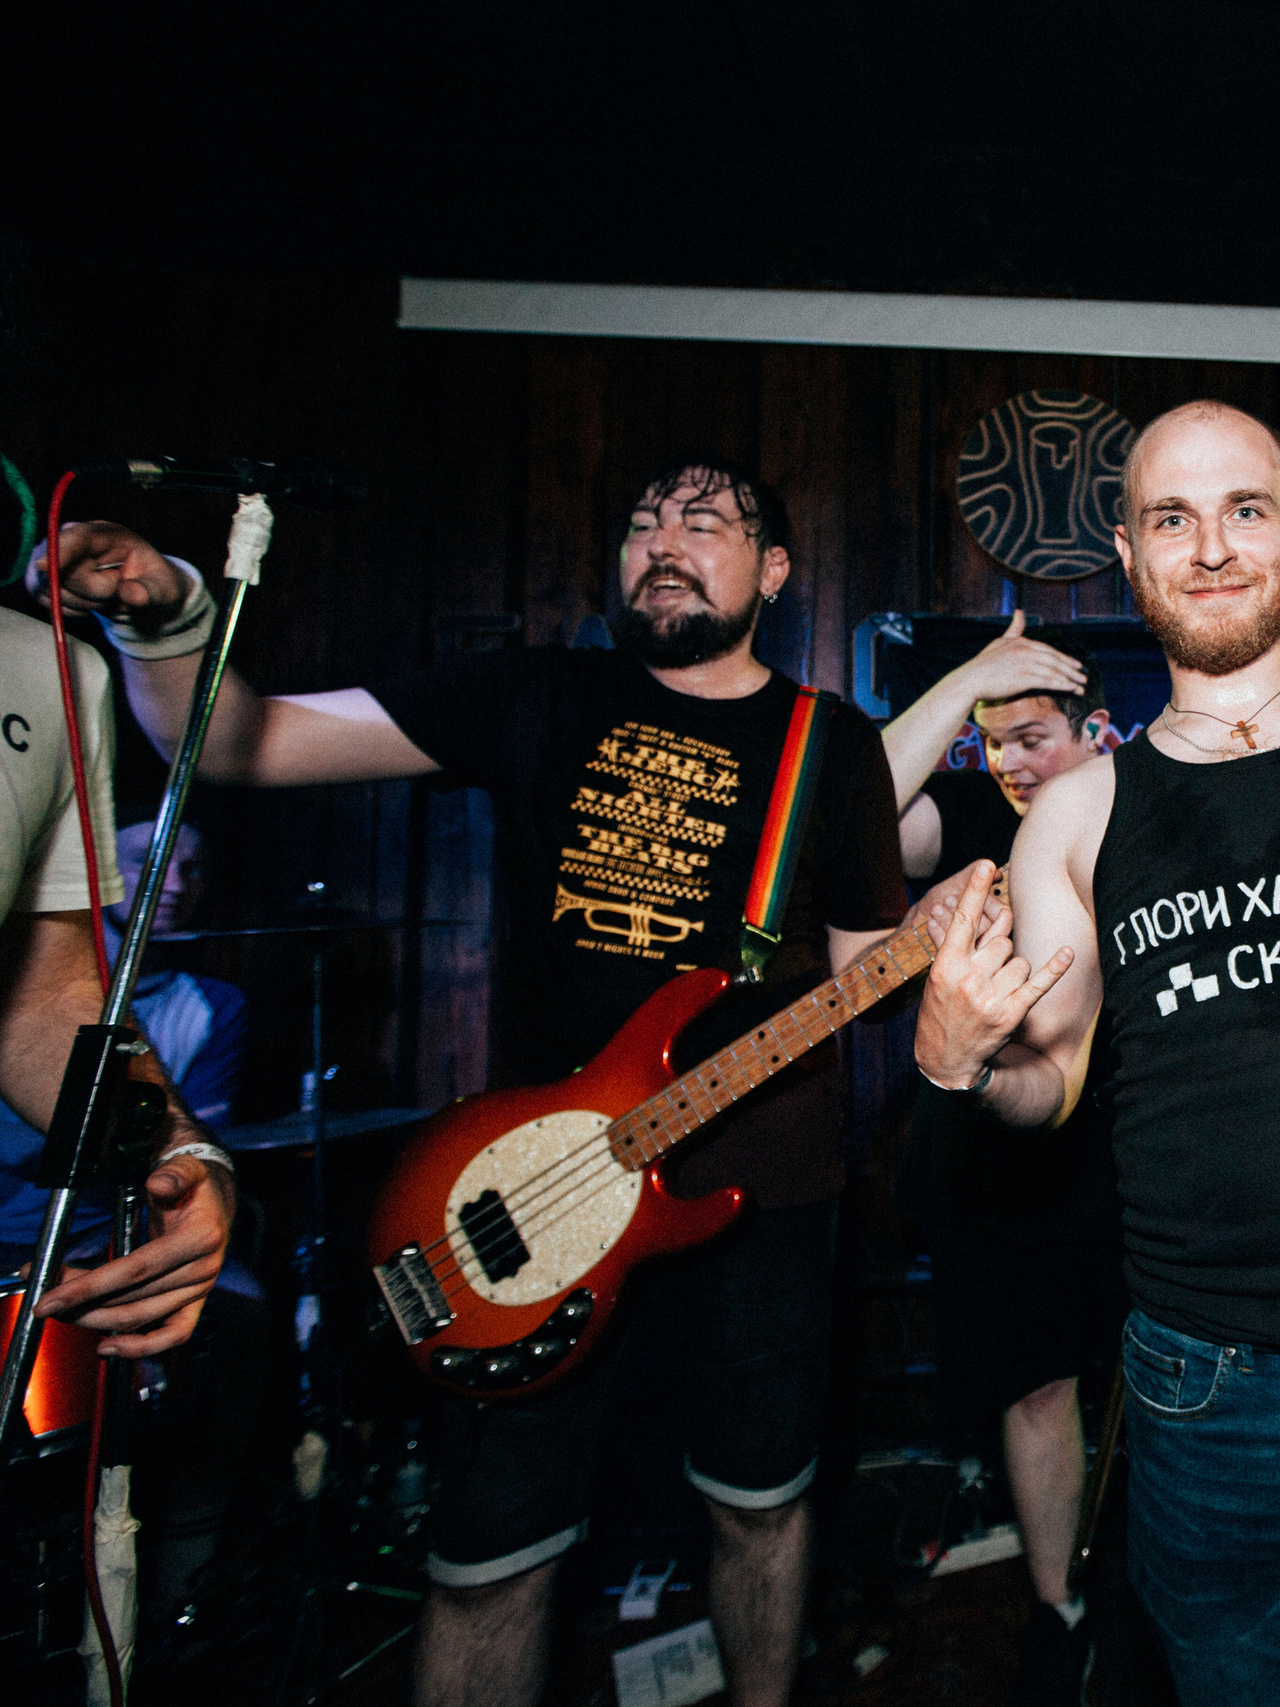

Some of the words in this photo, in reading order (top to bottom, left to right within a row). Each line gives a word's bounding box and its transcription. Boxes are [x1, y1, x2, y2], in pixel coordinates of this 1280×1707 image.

[634, 744, 707, 773] THE
[576, 786, 728, 838] NIGHTER
[623, 790, 687, 816] ALL
[576, 823, 645, 851] THE
[649, 842, 710, 868] BIG
[586, 839, 694, 875] BEATS
[1112, 890, 1232, 966] ГЛОРИ
